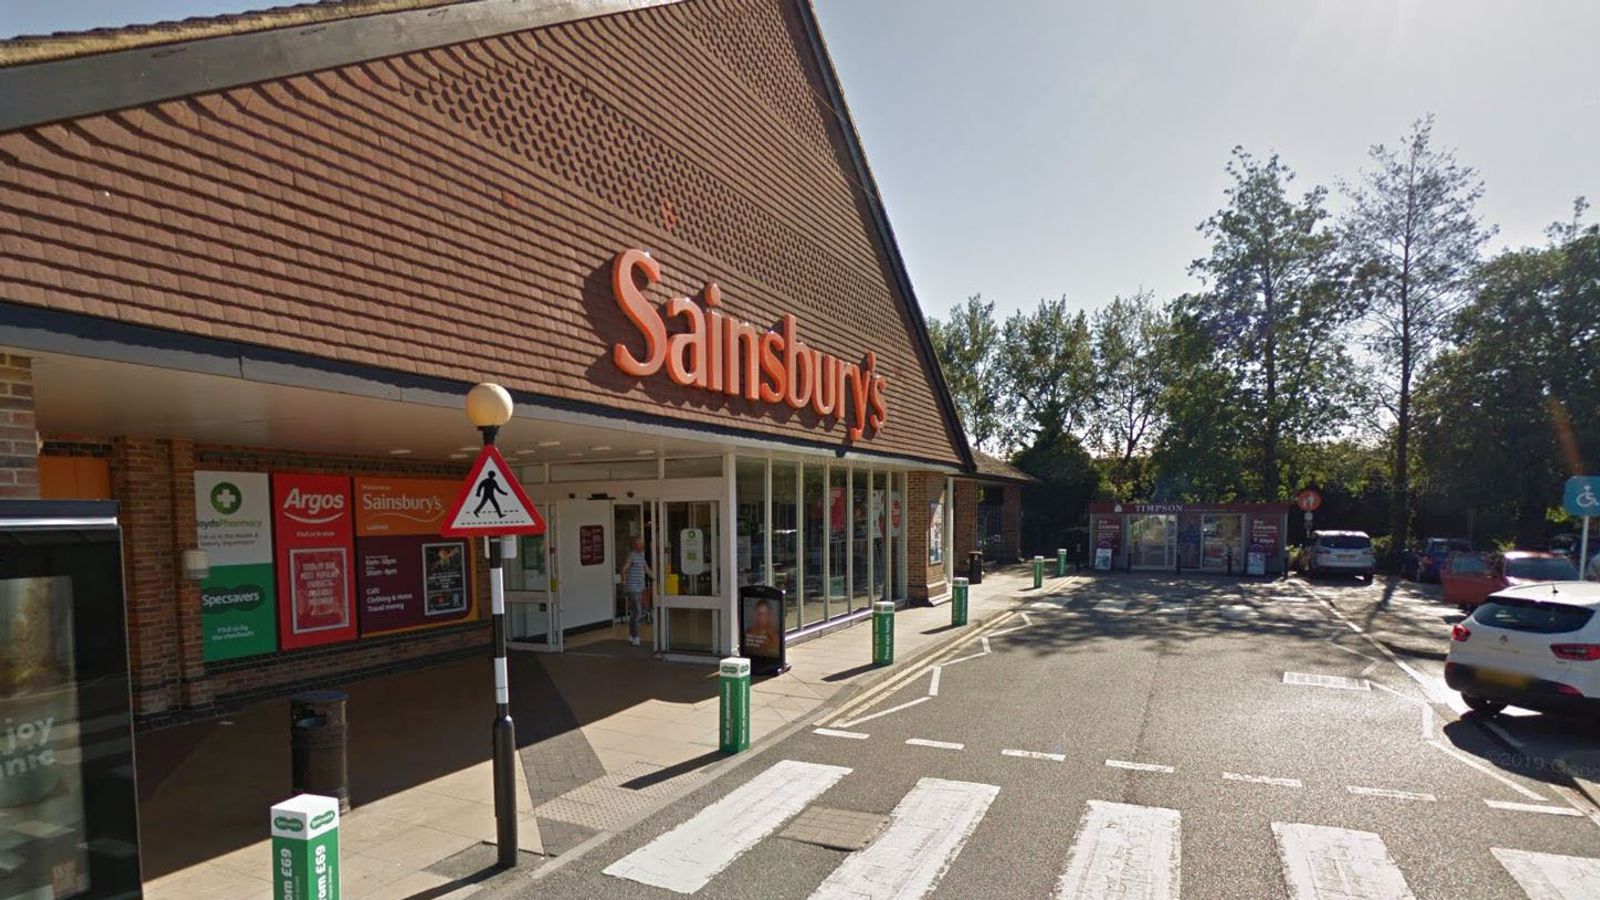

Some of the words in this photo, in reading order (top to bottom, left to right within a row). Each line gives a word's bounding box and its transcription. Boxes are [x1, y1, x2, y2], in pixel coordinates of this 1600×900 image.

[612, 249, 887, 441] Sainsbury's
[283, 487, 344, 514] Argos
[363, 493, 442, 513] Sainsbury's
[1135, 504, 1183, 513] TIMPSON
[202, 591, 260, 607] Specsavers
[280, 848, 292, 878] £69
[315, 844, 326, 874] £69
